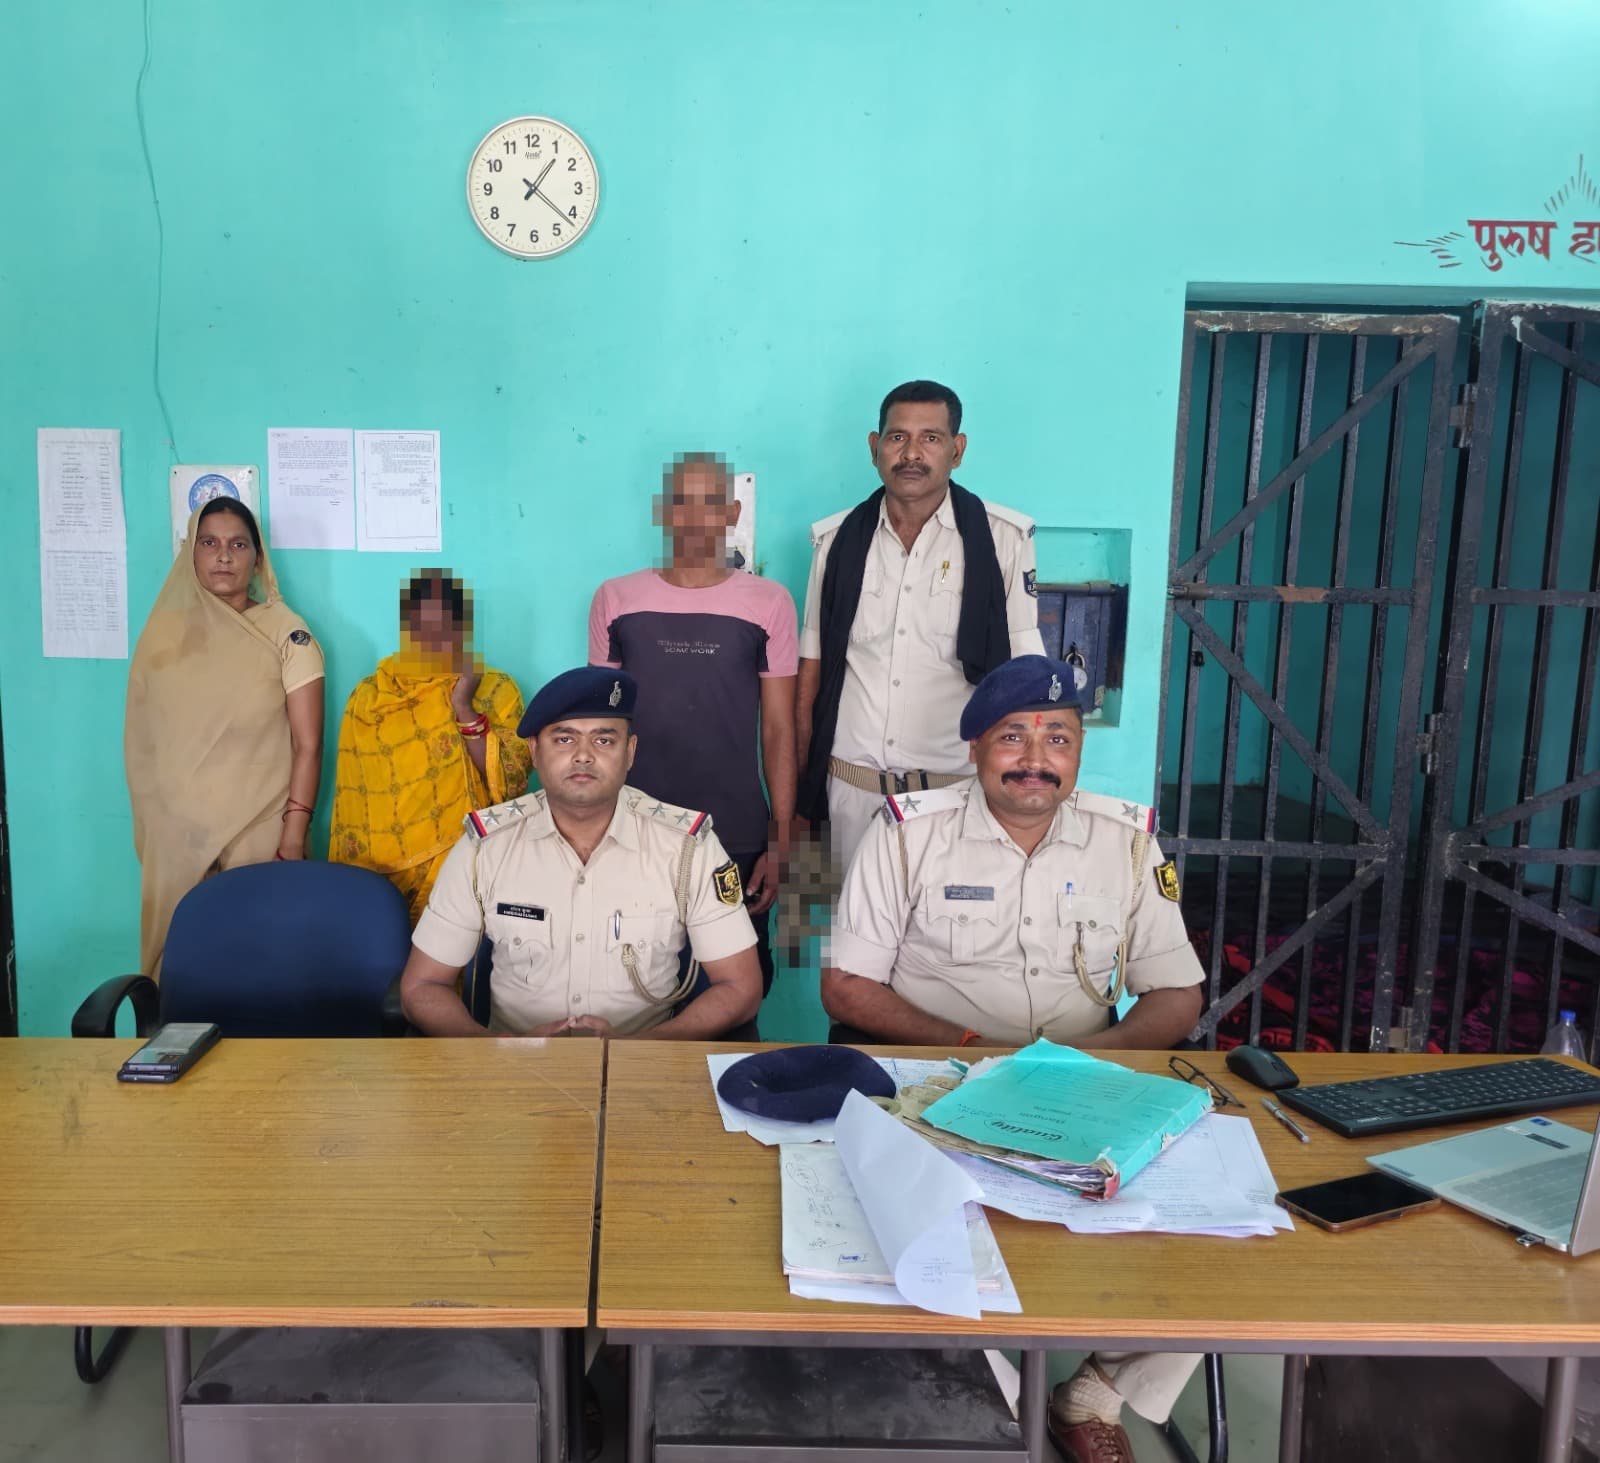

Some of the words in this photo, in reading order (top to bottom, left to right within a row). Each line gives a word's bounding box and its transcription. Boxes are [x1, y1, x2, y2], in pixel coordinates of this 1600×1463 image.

[525, 134, 540, 147] 12
[504, 141, 516, 154] 11
[552, 141, 558, 154] 1
[487, 159, 502, 172] 10
[568, 158, 576, 171] 2
[484, 183, 492, 196] 9
[574, 182, 583, 195] 3
[490, 207, 499, 219] 8
[568, 206, 577, 218] 4
[507, 224, 516, 237] 7
[530, 230, 539, 243] 6
[553, 224, 561, 236] 5
[1467, 219, 1558, 272] पुरुष
[991, 1120, 1063, 1141] Quality
